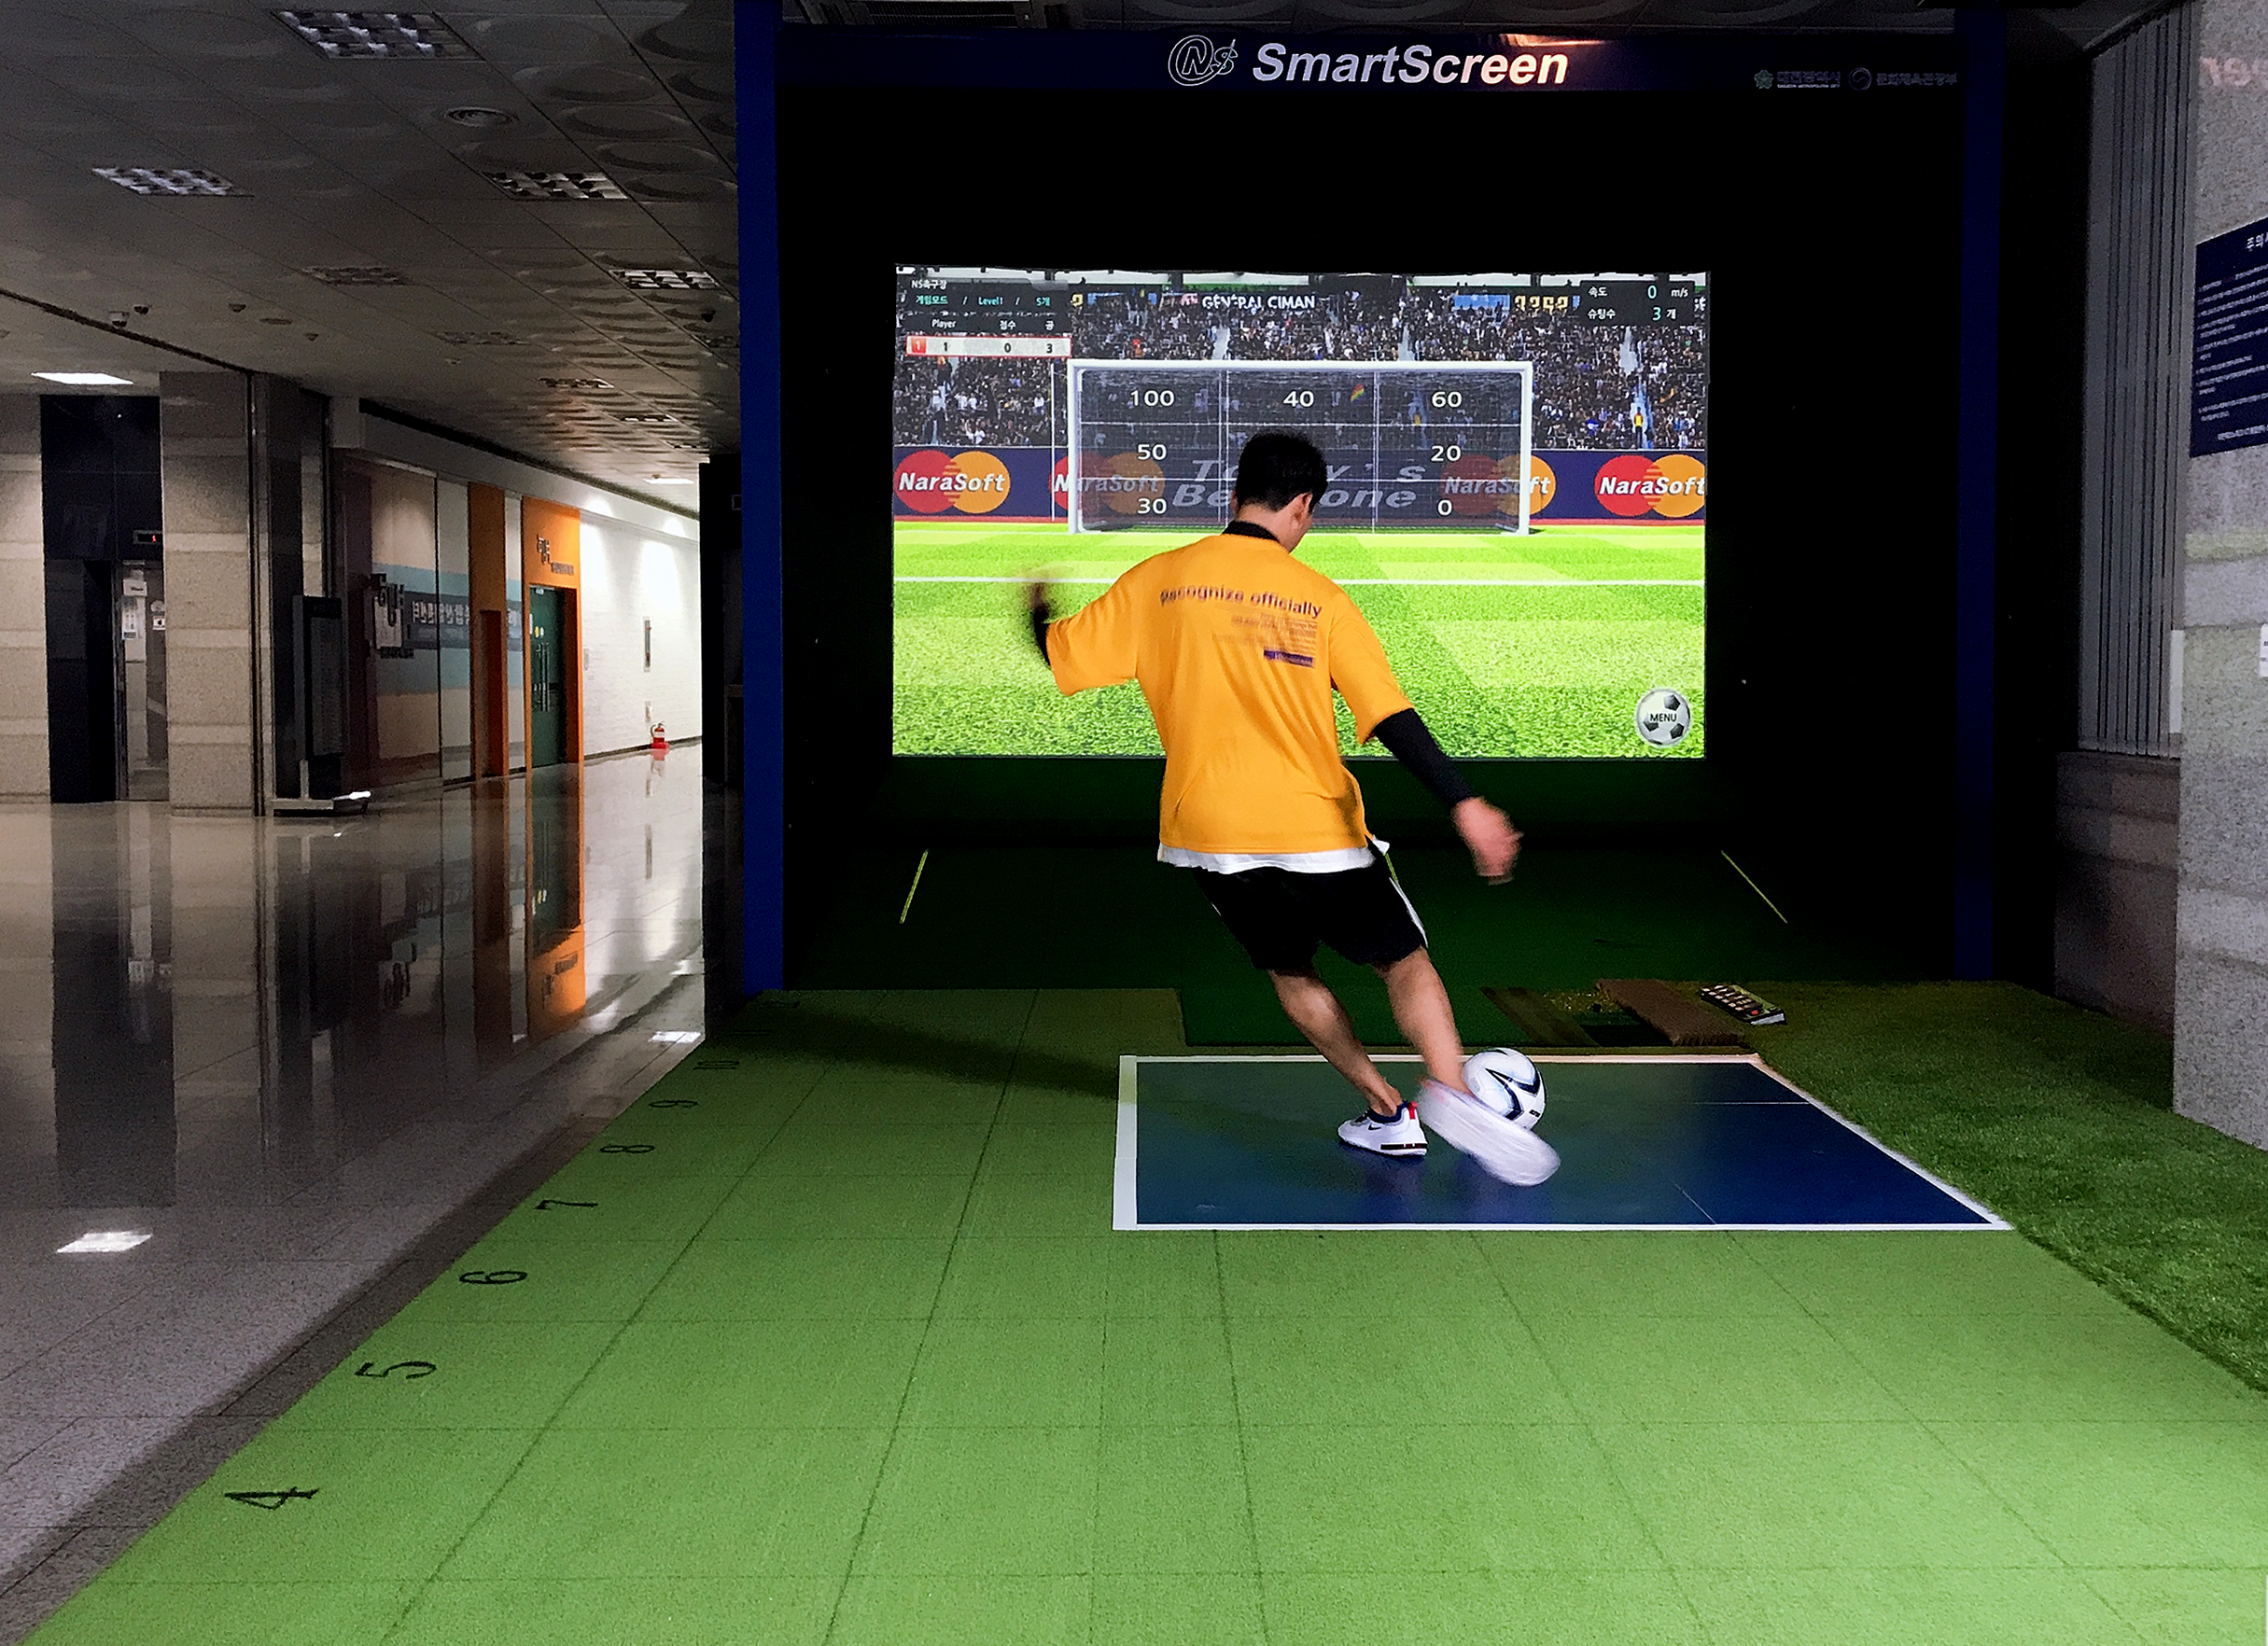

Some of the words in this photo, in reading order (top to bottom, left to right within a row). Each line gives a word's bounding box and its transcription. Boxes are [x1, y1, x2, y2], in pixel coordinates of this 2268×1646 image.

[1252, 42, 1569, 86] SmartScreen
[915, 295, 949, 305] 게임모드
[1589, 286, 1607, 298] 속도
[1647, 285, 1658, 300] 0
[1671, 287, 1688, 299] m/s
[1267, 295, 1316, 310] CIMAN
[1587, 307, 1617, 320] 슈팅수
[1651, 306, 1662, 321] 3
[1666, 308, 1677, 320] 개
[931, 319, 958, 329] Player
[999, 319, 1016, 331] 점수
[943, 342, 949, 352] 1
[1003, 342, 1012, 354] 0
[1045, 342, 1054, 354] 3
[1130, 391, 1175, 408] 100
[1282, 391, 1315, 408] 40
[1431, 391, 1463, 409] 60
[1137, 443, 1168, 461] 50
[1430, 444, 1462, 462] 20
[898, 472, 1006, 493] NaraSoft
[1053, 473, 1159, 494] NraSoft
[1599, 476, 1705, 495] NaraSoft
[1137, 496, 1168, 515] 30
[1436, 498, 1453, 516] 0
[1250, 591, 1323, 618] officially
[1649, 713, 1677, 722] MENU
[599, 1144, 655, 1154] 8
[534, 1199, 598, 1210] 7
[459, 1270, 528, 1286] 6
[355, 1360, 437, 1380] 5
[224, 1486, 320, 1510] 4
